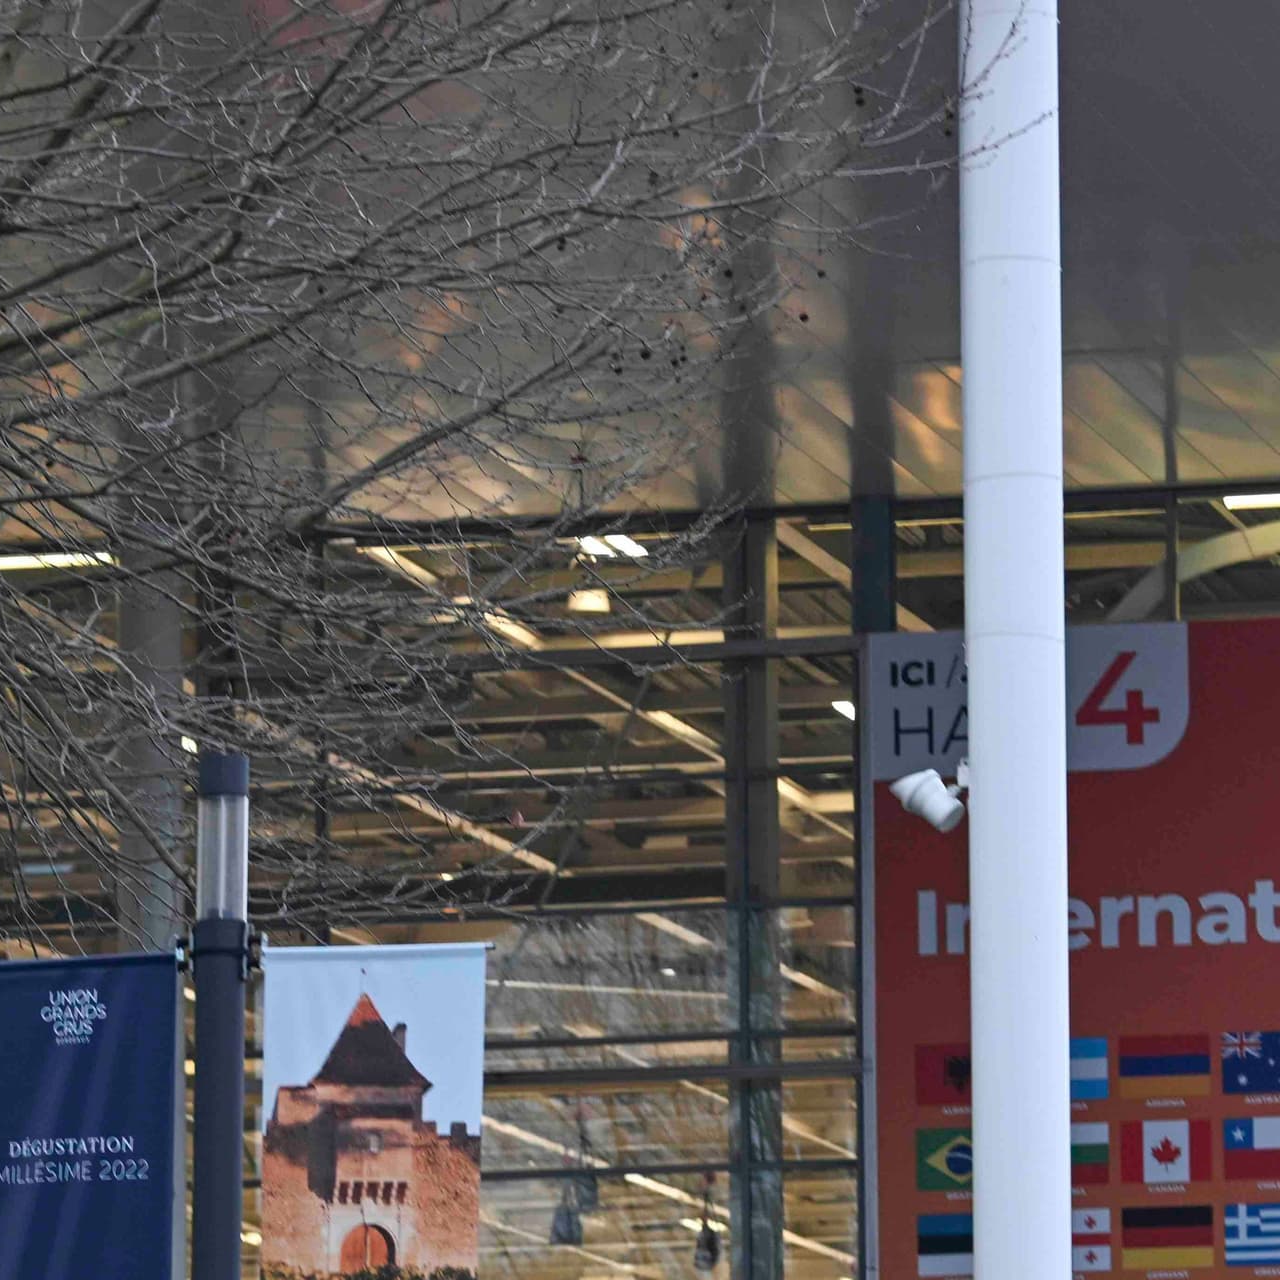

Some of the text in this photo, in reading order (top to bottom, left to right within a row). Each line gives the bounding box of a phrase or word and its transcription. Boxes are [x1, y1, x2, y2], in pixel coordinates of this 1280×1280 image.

[890, 661, 936, 688] ICI
[1076, 651, 1160, 746] 4
[49, 987, 99, 1006] UNION
[40, 1002, 107, 1022] GRANDS
[53, 1019, 94, 1036] CRUS
[8, 1135, 134, 1159] DÉGUSTATION
[98, 1157, 150, 1182] 2022
